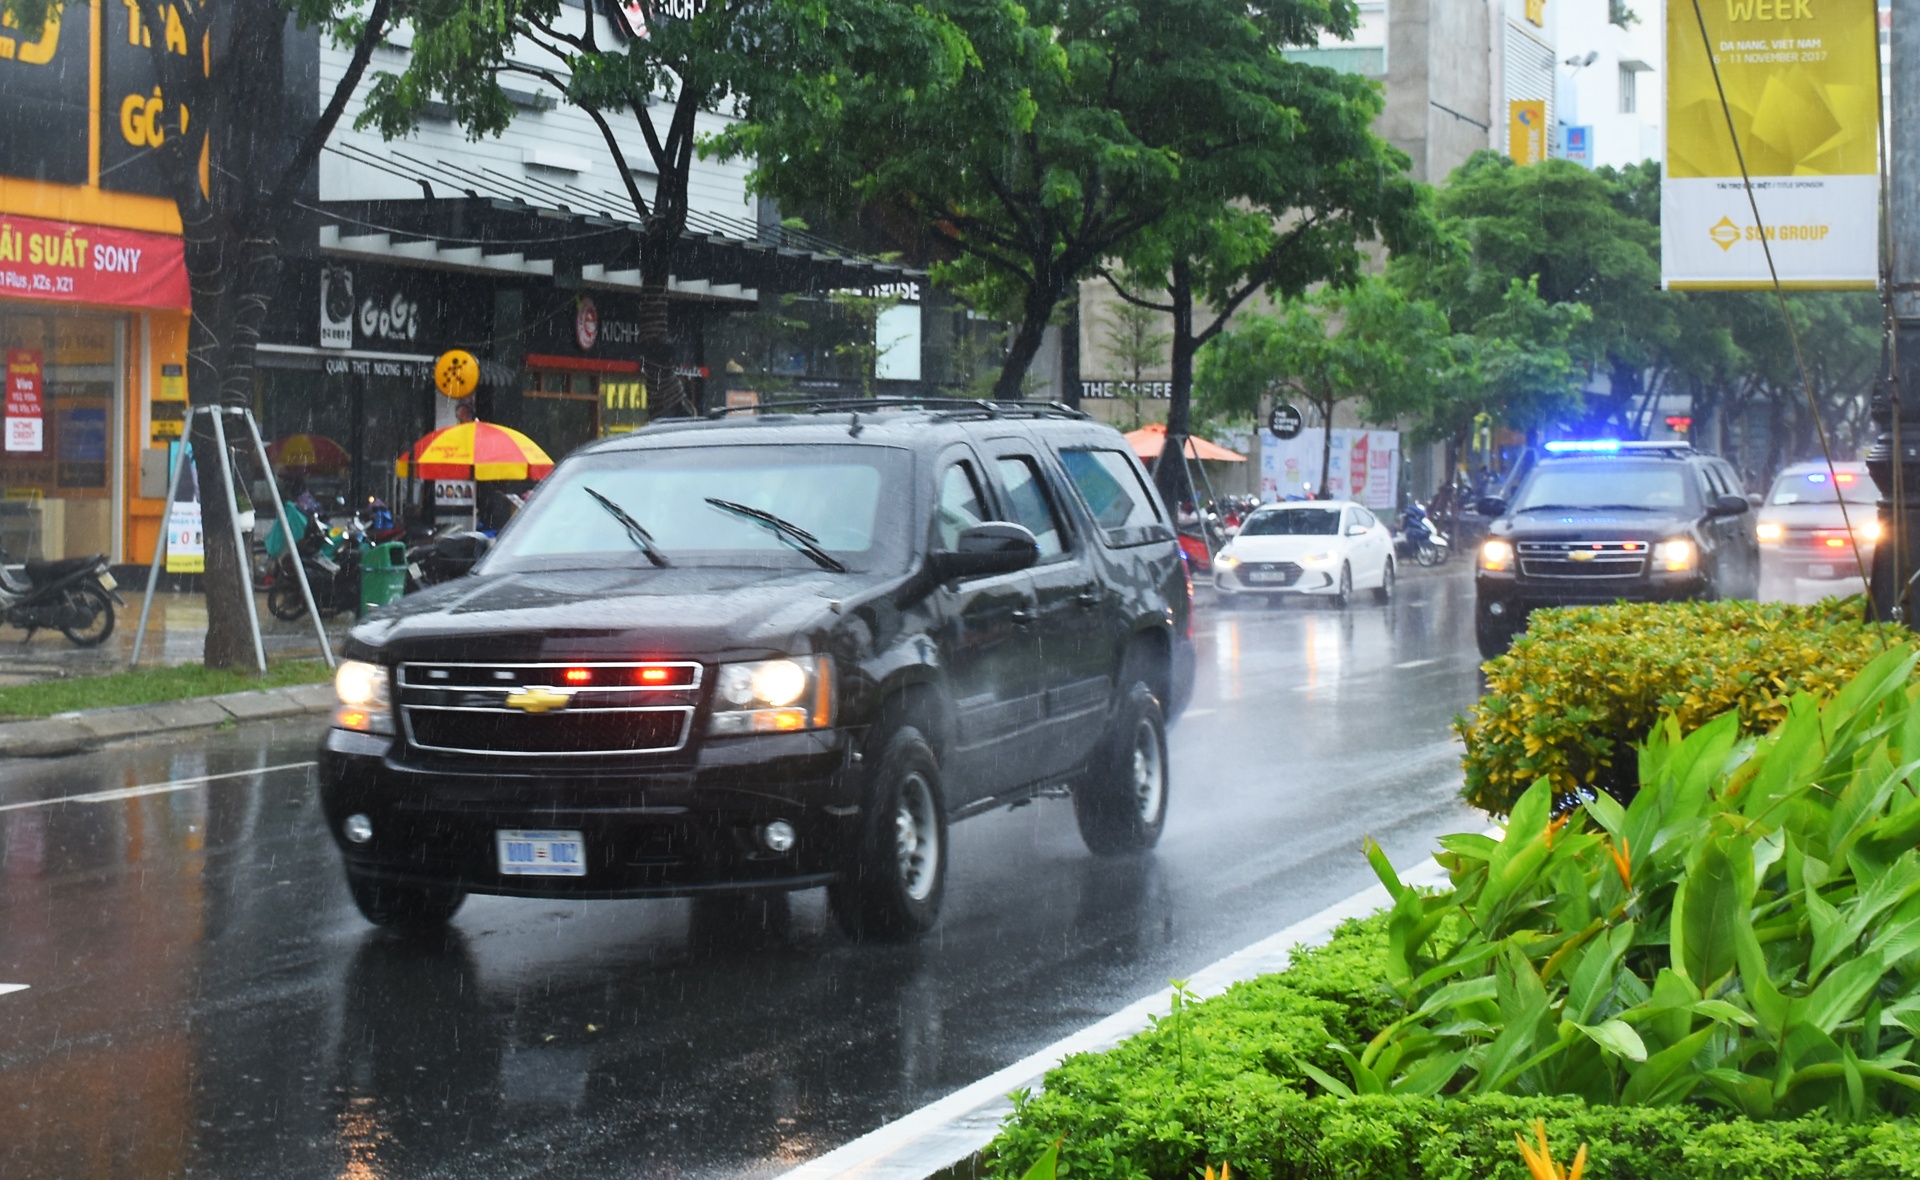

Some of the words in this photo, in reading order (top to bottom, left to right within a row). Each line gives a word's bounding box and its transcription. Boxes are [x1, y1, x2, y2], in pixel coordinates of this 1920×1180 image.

[1726, 0, 1814, 21] WEEK
[1797, 38, 1821, 49] NAM
[1730, 54, 1741, 63] 11
[1744, 52, 1799, 63] NOVEMBER
[1801, 51, 1828, 62] 2017
[1780, 225, 1829, 240] GROUP
[93, 244, 141, 273] SONY
[1081, 382, 1114, 397] THE
